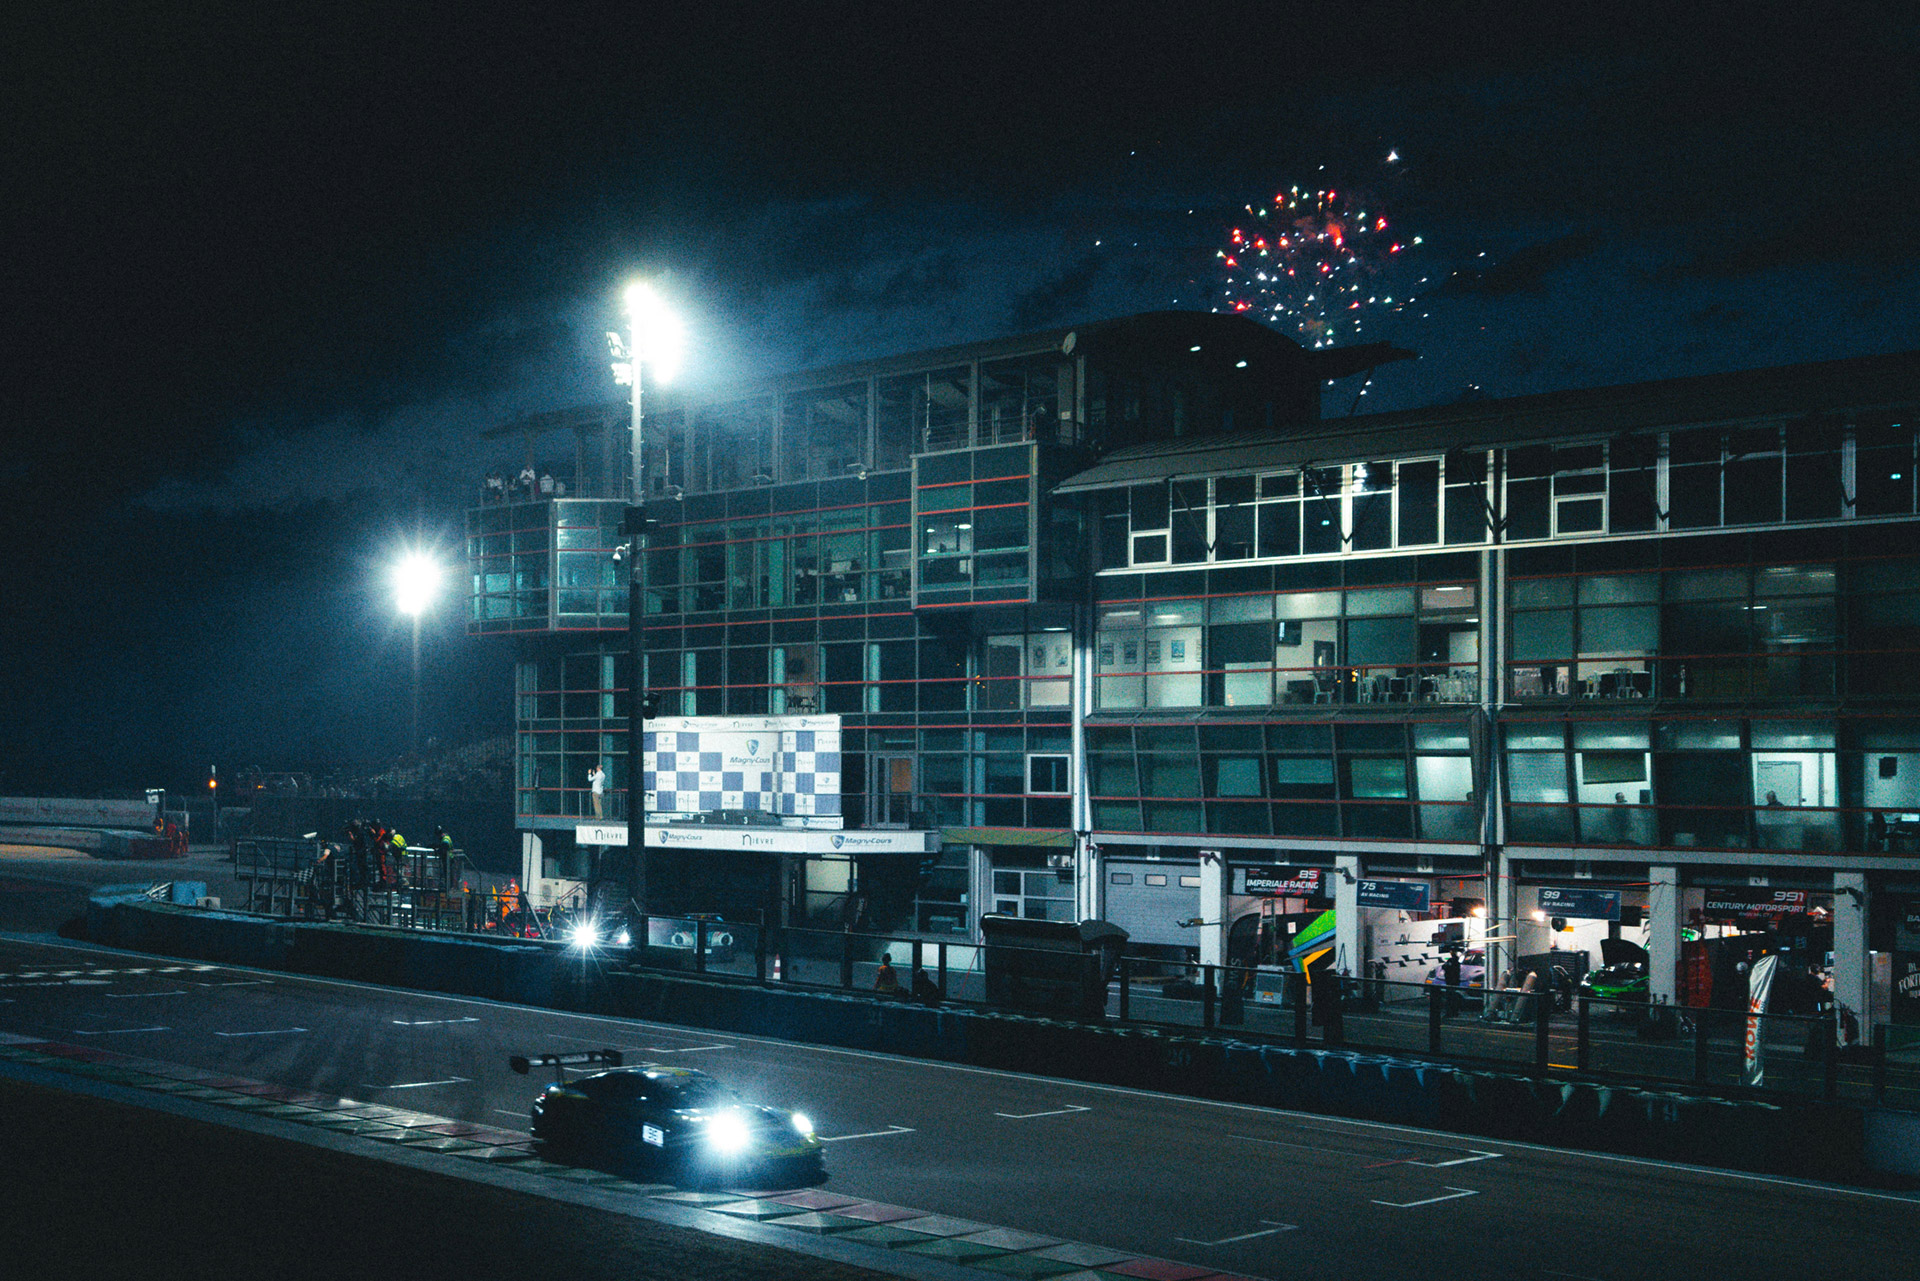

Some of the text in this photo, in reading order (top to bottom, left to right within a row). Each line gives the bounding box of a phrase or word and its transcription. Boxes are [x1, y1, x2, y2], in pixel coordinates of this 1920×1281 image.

[700, 815, 705, 824] 2
[743, 816, 749, 824] 3
[845, 837, 893, 846] Magny-Cours
[1299, 869, 1318, 879] 85
[1246, 879, 1319, 889] IMPERIALE RACING
[1362, 881, 1376, 891] 75
[1543, 890, 1561, 899] 99
[1773, 891, 1805, 902] 991
[1706, 901, 1806, 913] CENTURY MOTORSPORT
